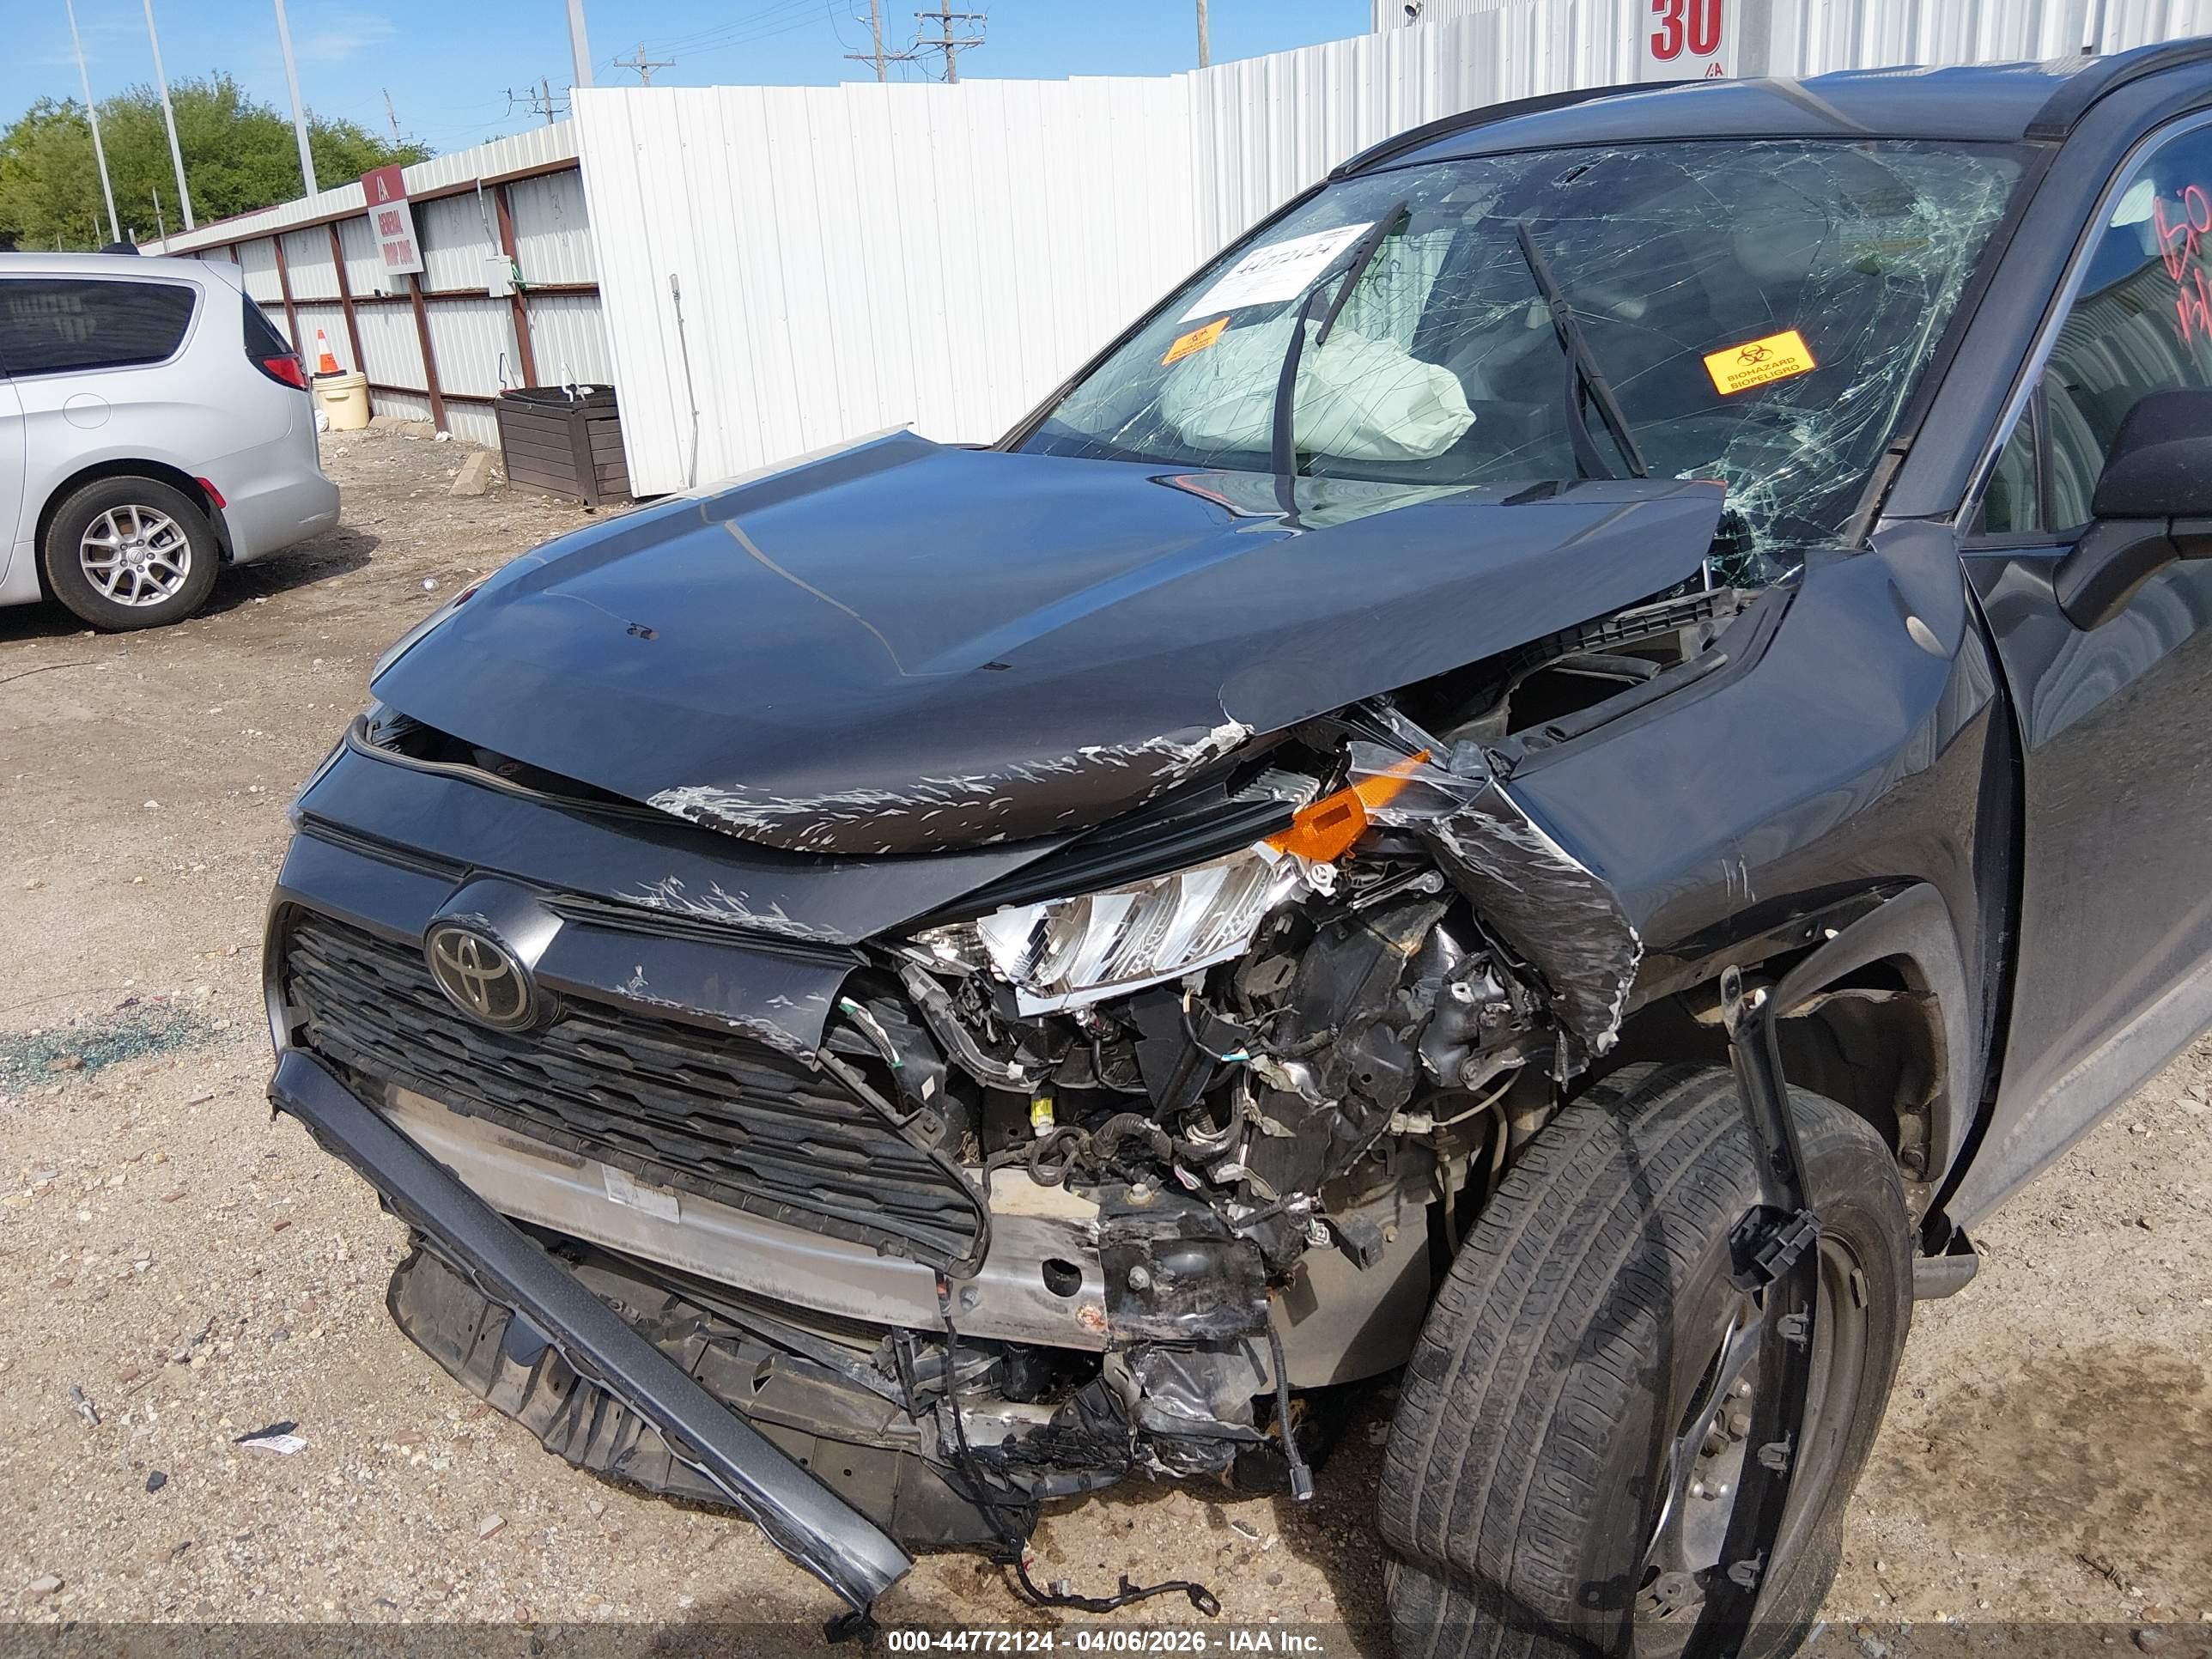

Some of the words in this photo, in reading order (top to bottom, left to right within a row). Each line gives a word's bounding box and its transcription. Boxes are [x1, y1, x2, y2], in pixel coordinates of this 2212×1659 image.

[1650, 0, 1723, 62] 30
[1237, 240, 1338, 276] 44772124
[1727, 357, 1796, 382] BIOHAZARD
[1730, 364, 1801, 390] BIOPELIGRO
